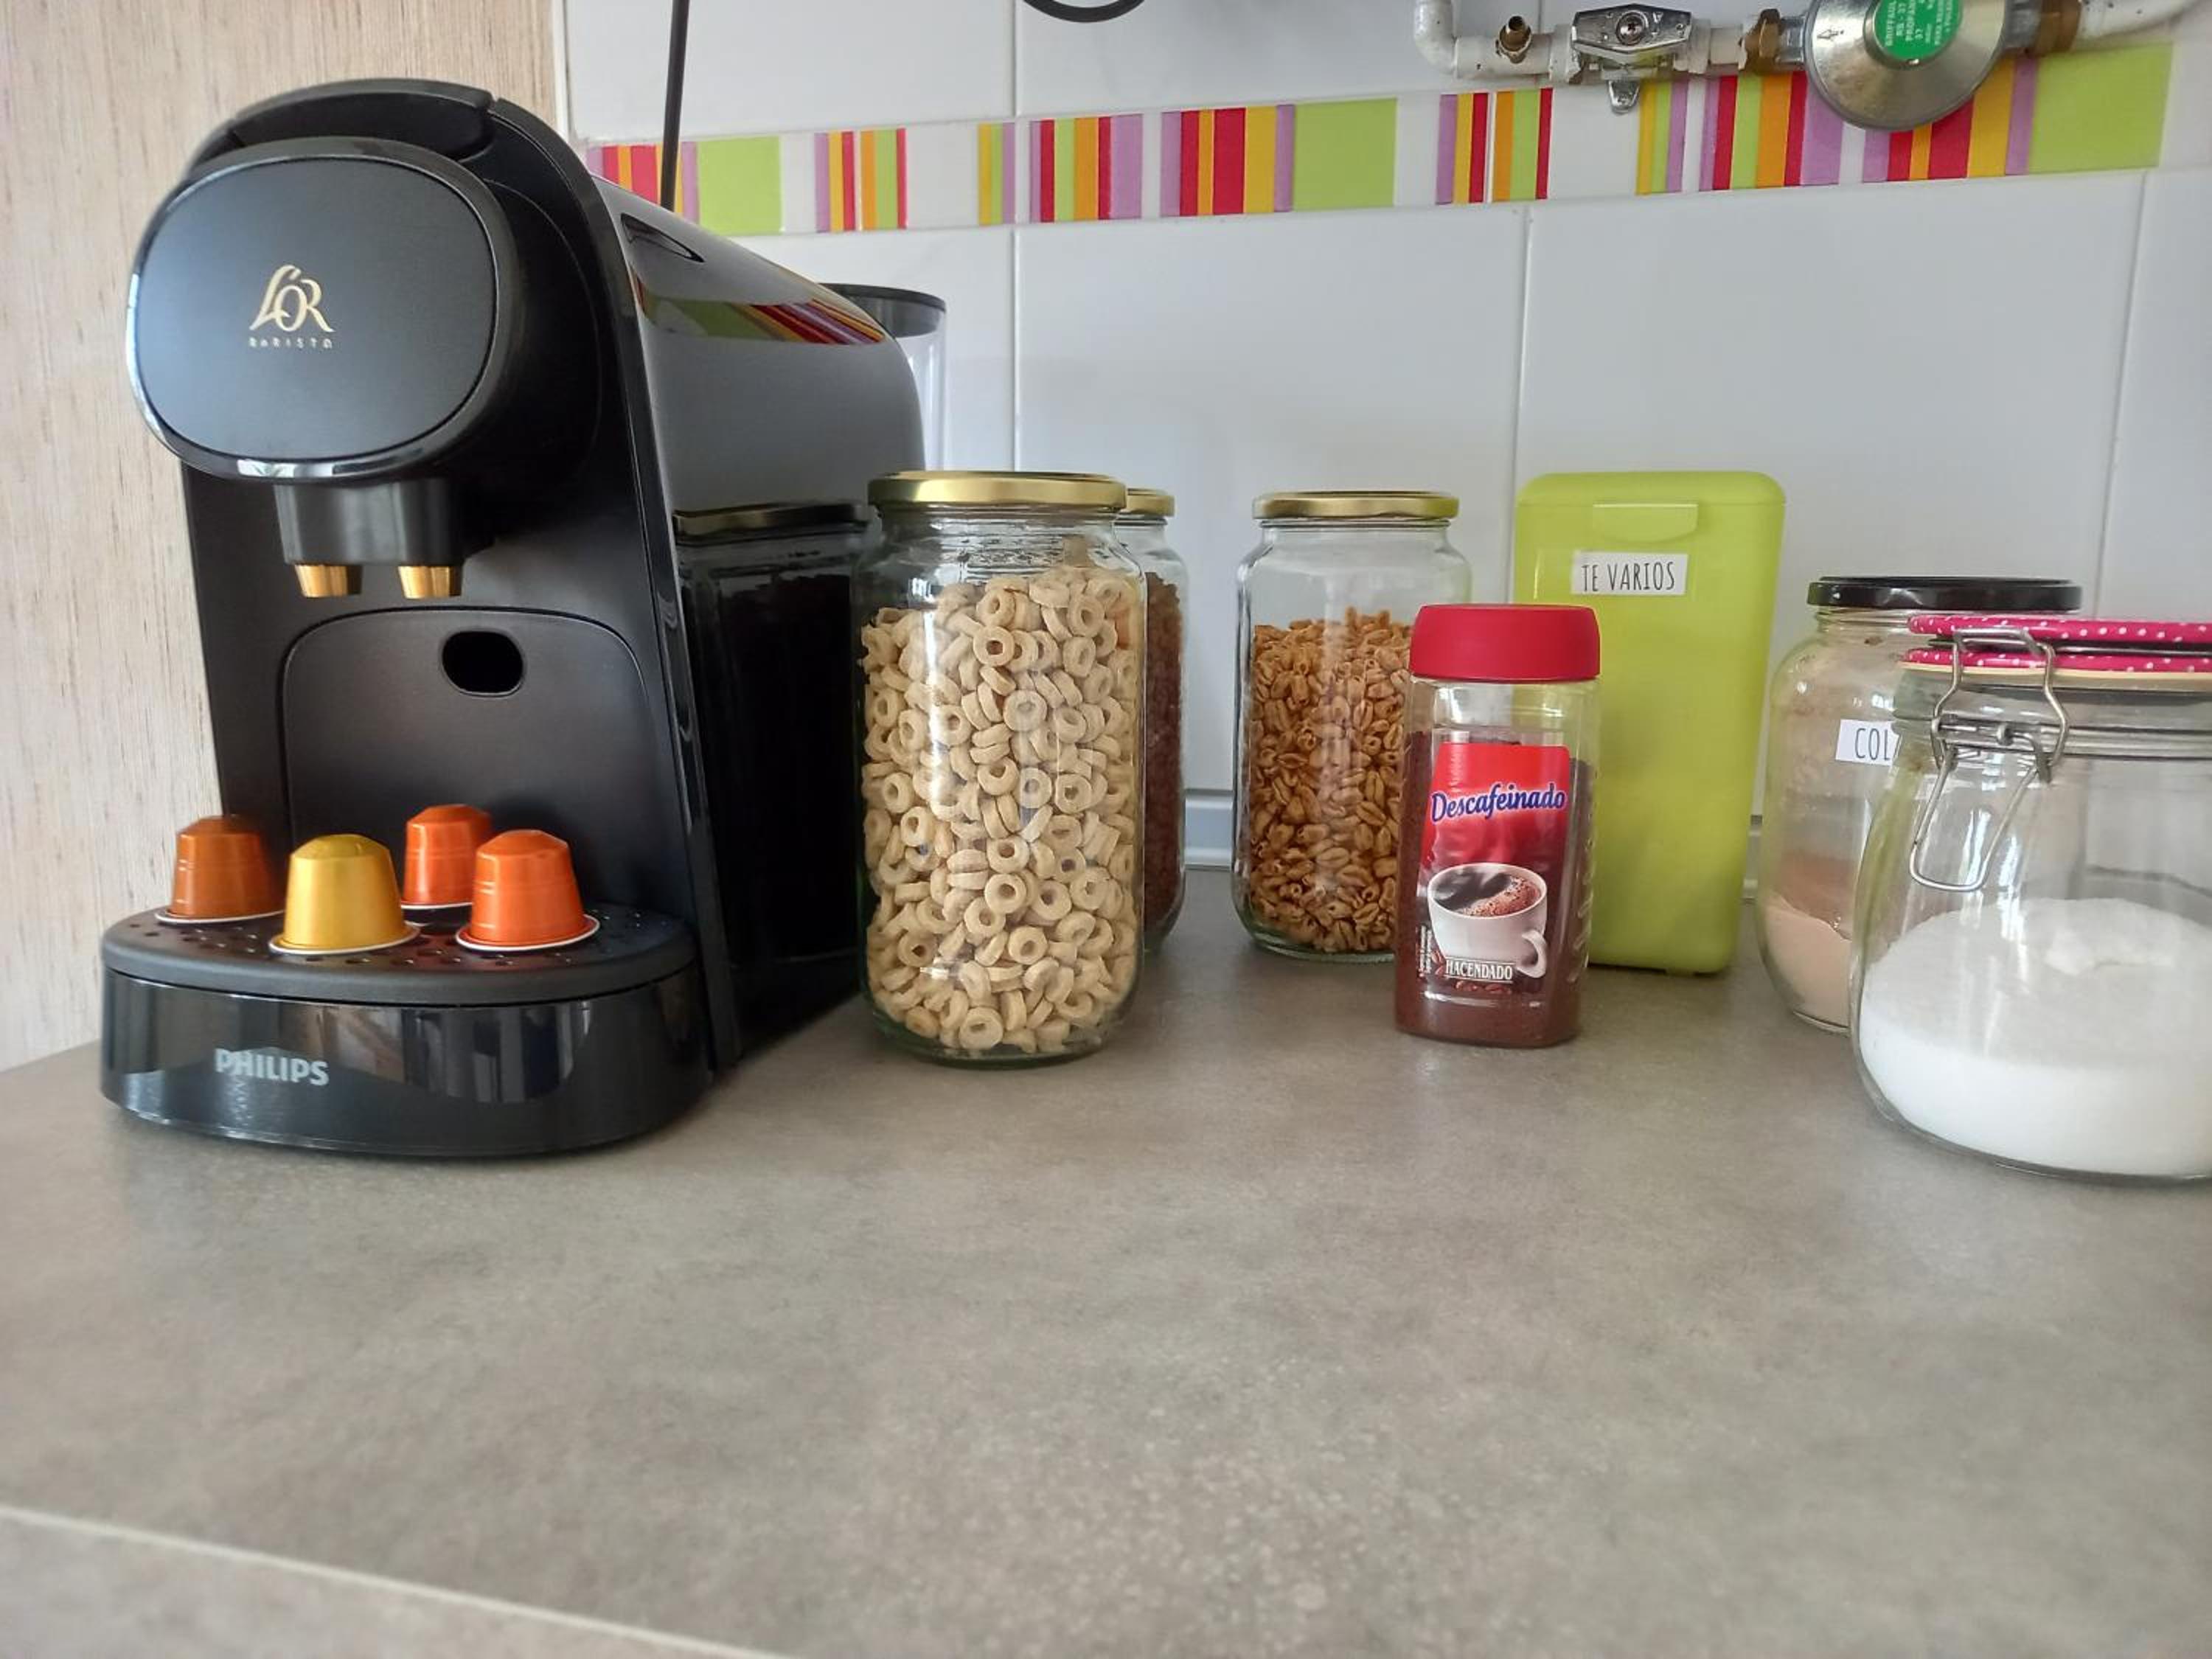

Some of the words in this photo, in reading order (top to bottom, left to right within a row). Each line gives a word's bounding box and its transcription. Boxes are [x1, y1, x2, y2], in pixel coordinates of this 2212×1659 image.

[1582, 564, 1599, 591] TE
[1607, 561, 1674, 591] VARIOS
[1431, 782, 1565, 822] Descafeinado
[1446, 959, 1513, 980] HACENDADO
[215, 1048, 330, 1086] PHILIPS
